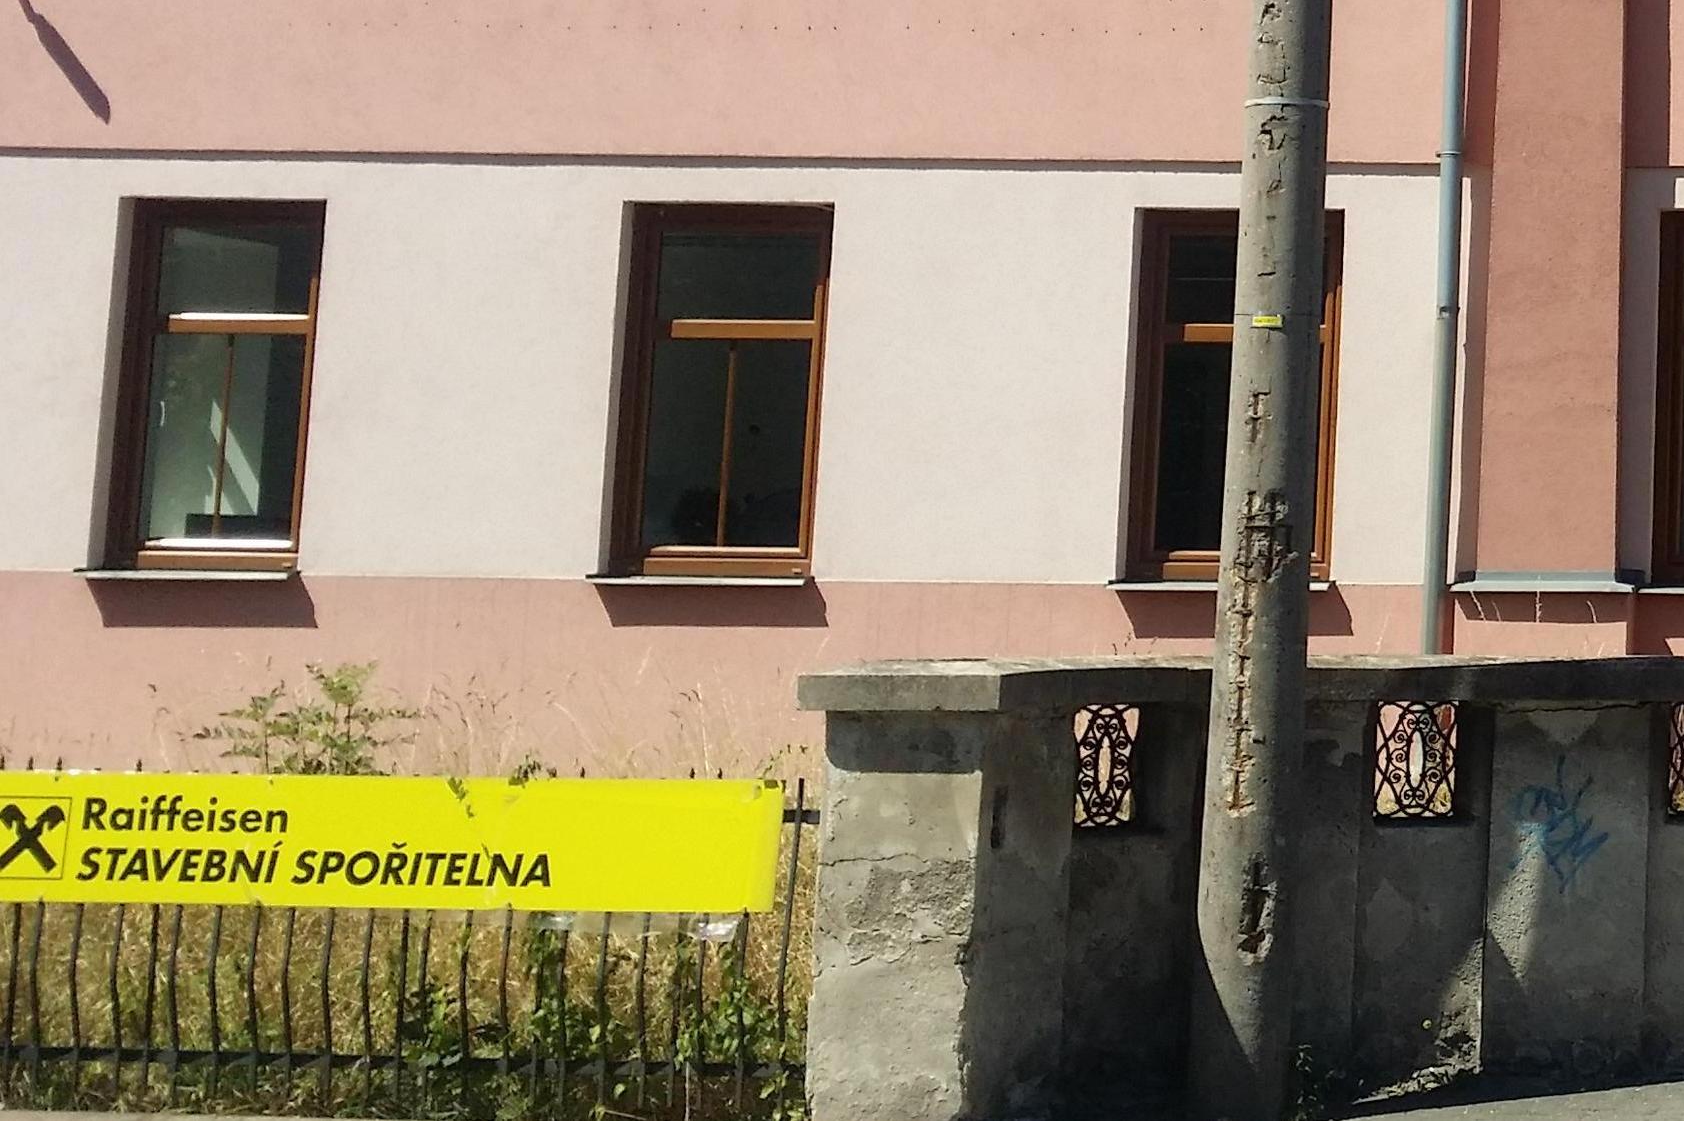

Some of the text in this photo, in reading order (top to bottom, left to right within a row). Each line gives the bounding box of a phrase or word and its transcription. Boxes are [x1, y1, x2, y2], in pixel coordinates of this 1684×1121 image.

[82, 795, 288, 833] Raiffeisen
[75, 841, 551, 887] STAVEBNÍ SPOŘITELNA
